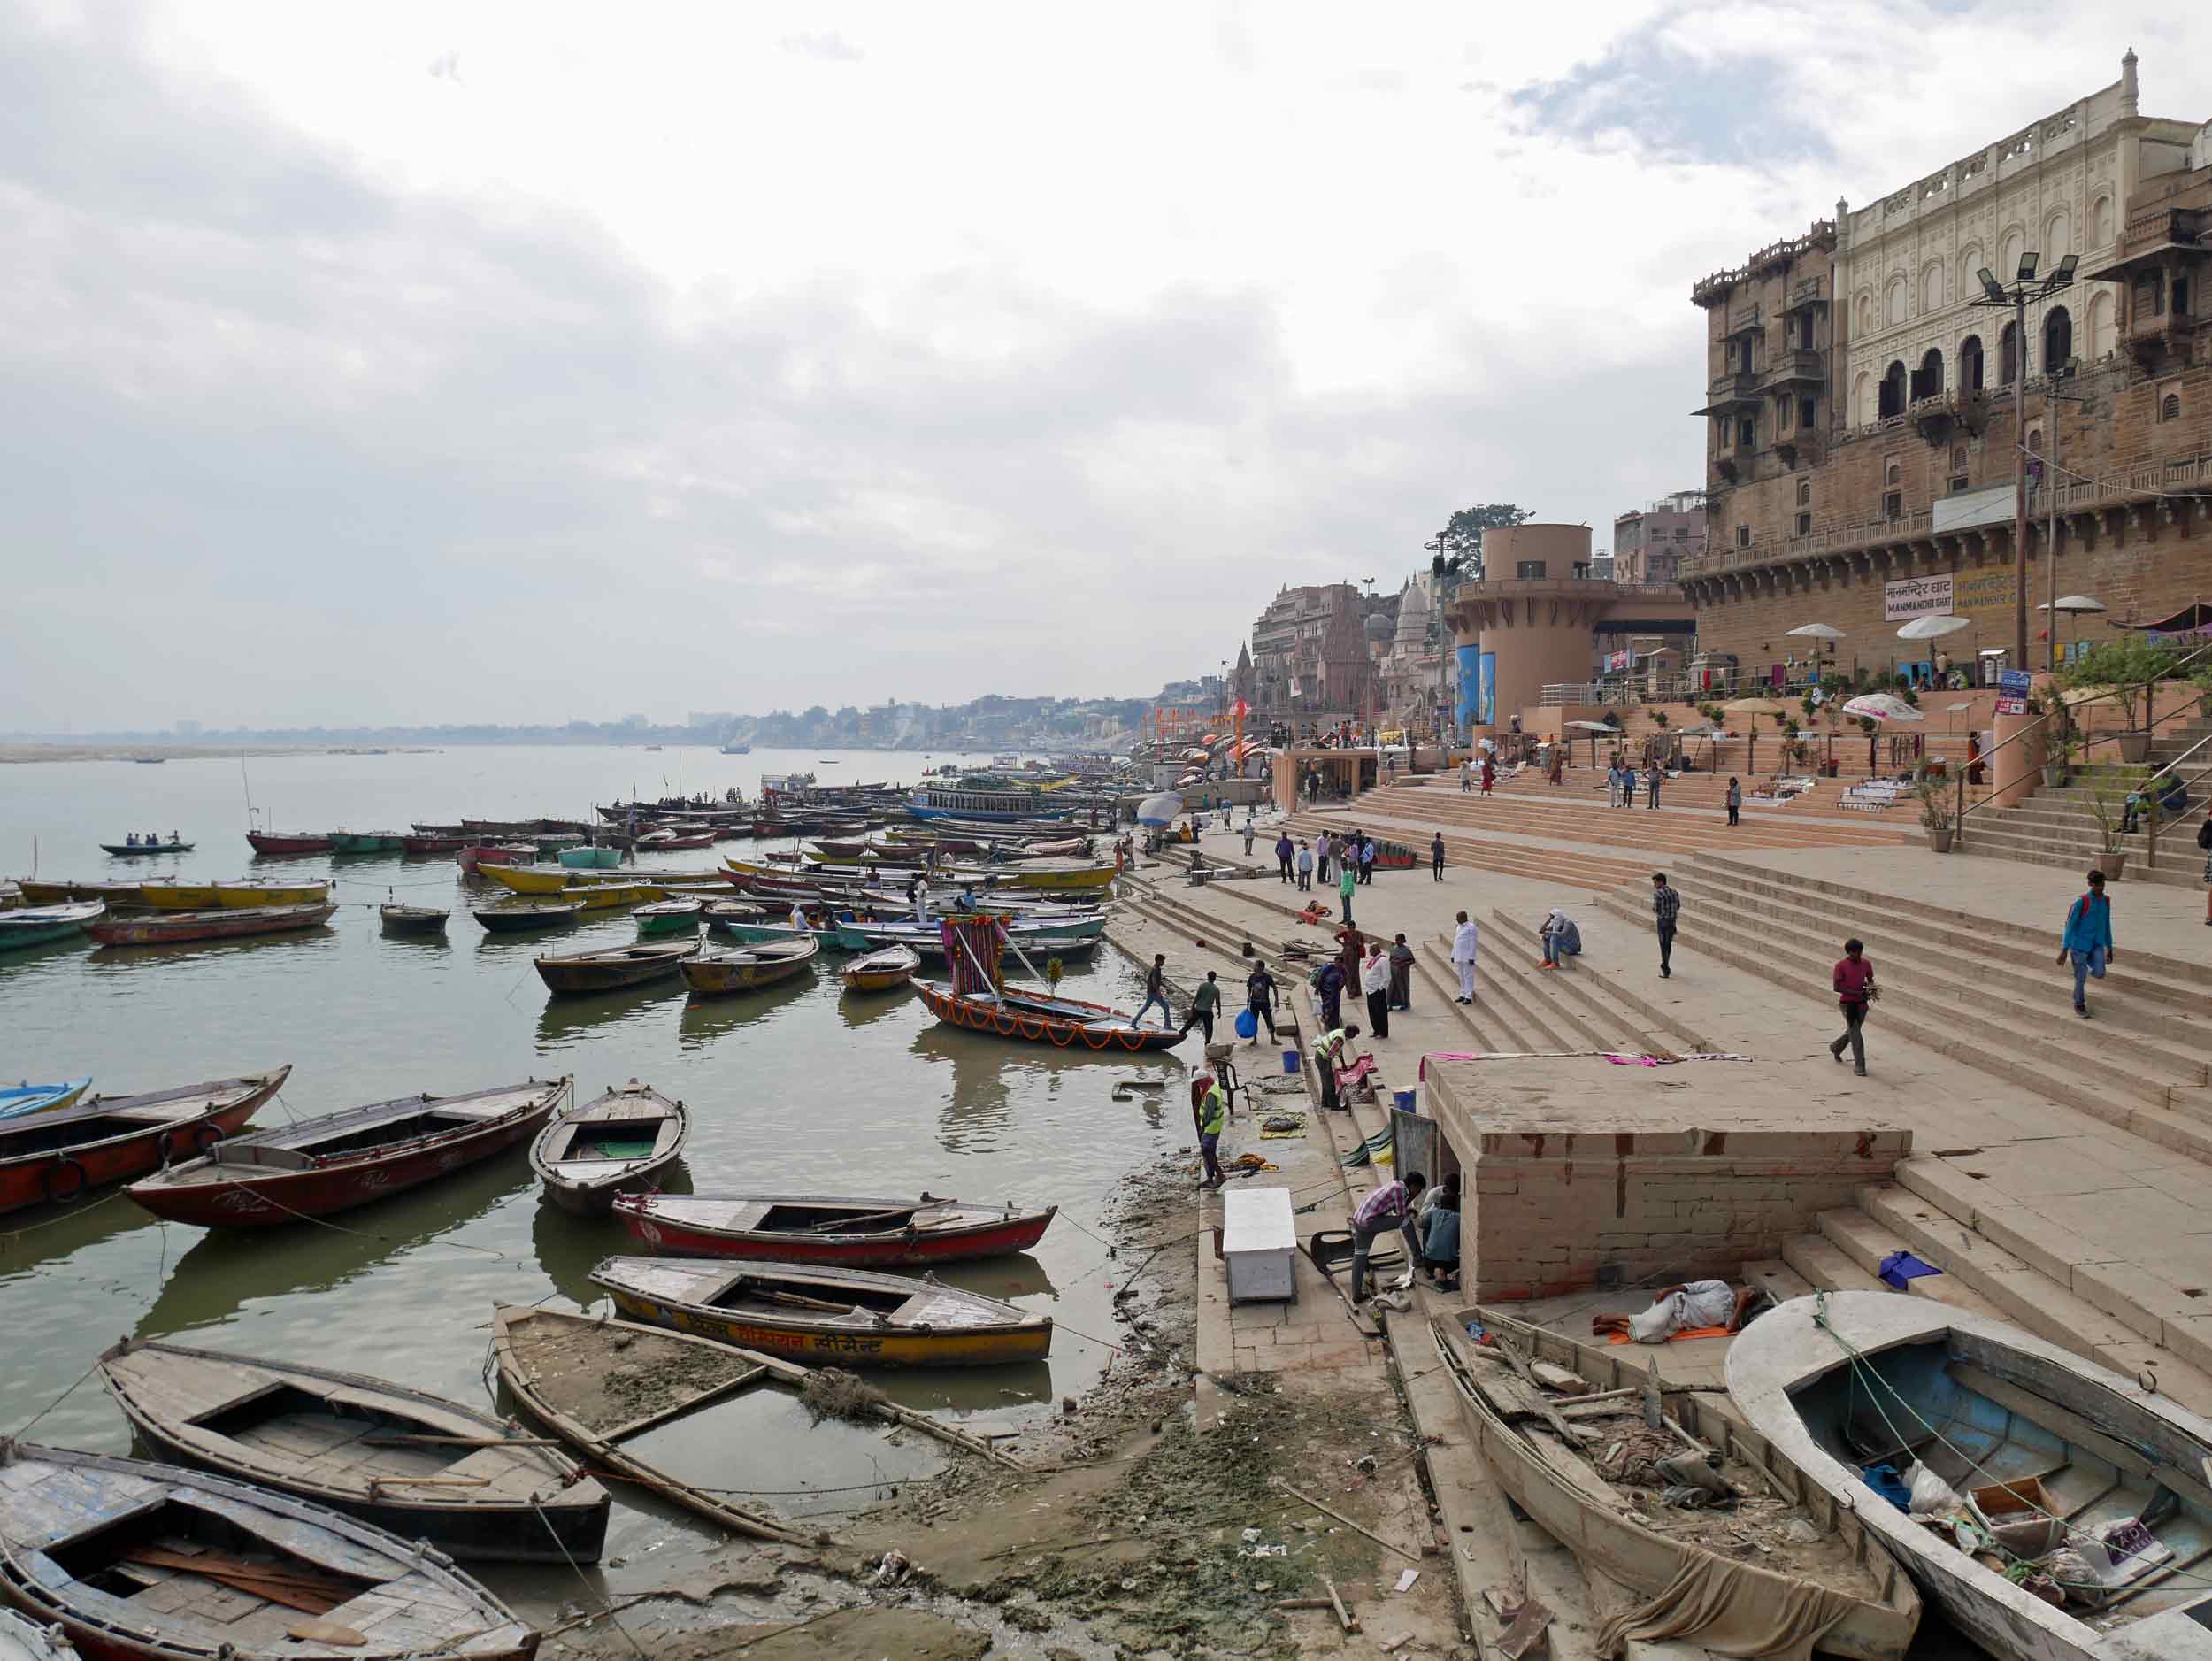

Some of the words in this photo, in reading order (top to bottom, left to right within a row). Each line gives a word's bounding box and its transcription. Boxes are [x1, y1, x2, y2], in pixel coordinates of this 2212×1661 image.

[1931, 580, 1952, 594] घाट
[1888, 597, 1934, 614] MANMANDIR
[1935, 596, 1952, 607] GHAT
